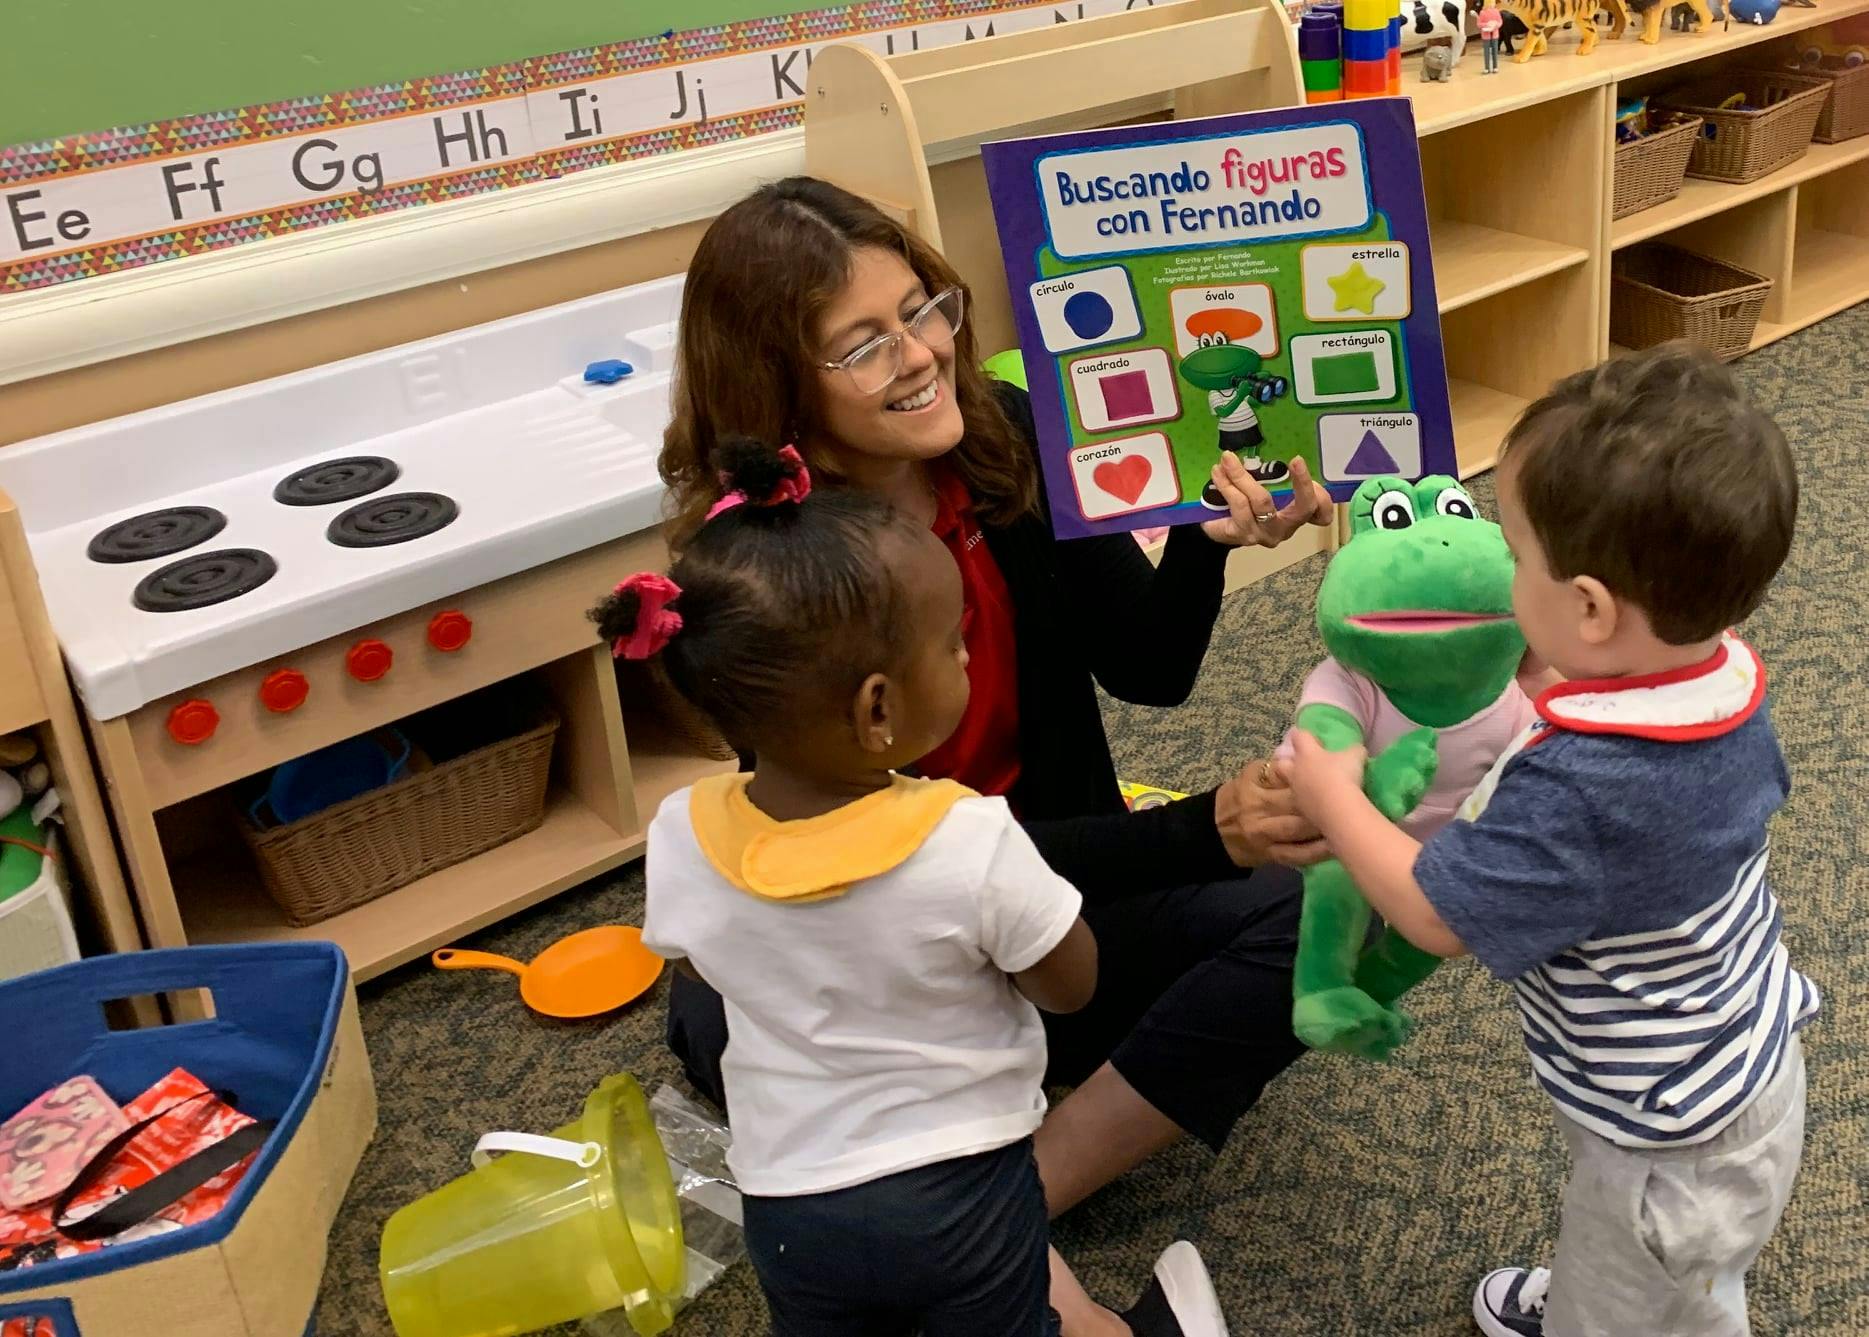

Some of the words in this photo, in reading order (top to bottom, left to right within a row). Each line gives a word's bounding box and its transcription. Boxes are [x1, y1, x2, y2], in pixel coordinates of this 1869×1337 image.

[7, 189, 92, 251] Ee
[162, 157, 225, 221] Ff
[292, 138, 384, 195] Gg
[433, 109, 509, 168] Hh
[559, 88, 604, 141] Ii
[670, 70, 708, 126] Jj
[1056, 161, 1210, 206] Buscando
[1220, 147, 1346, 195] figuras
[1096, 208, 1151, 236] con
[1160, 189, 1321, 234] Fernando
[1217, 252, 1251, 261] Fernando
[1352, 248, 1400, 260] estrella
[1036, 280, 1075, 297] círculo
[1205, 289, 1235, 302] óvalo
[1321, 334, 1385, 349] rectángulo
[1077, 358, 1130, 375] cuadrado
[1360, 416, 1413, 430] triángulo
[1076, 446, 1122, 463] corazón
